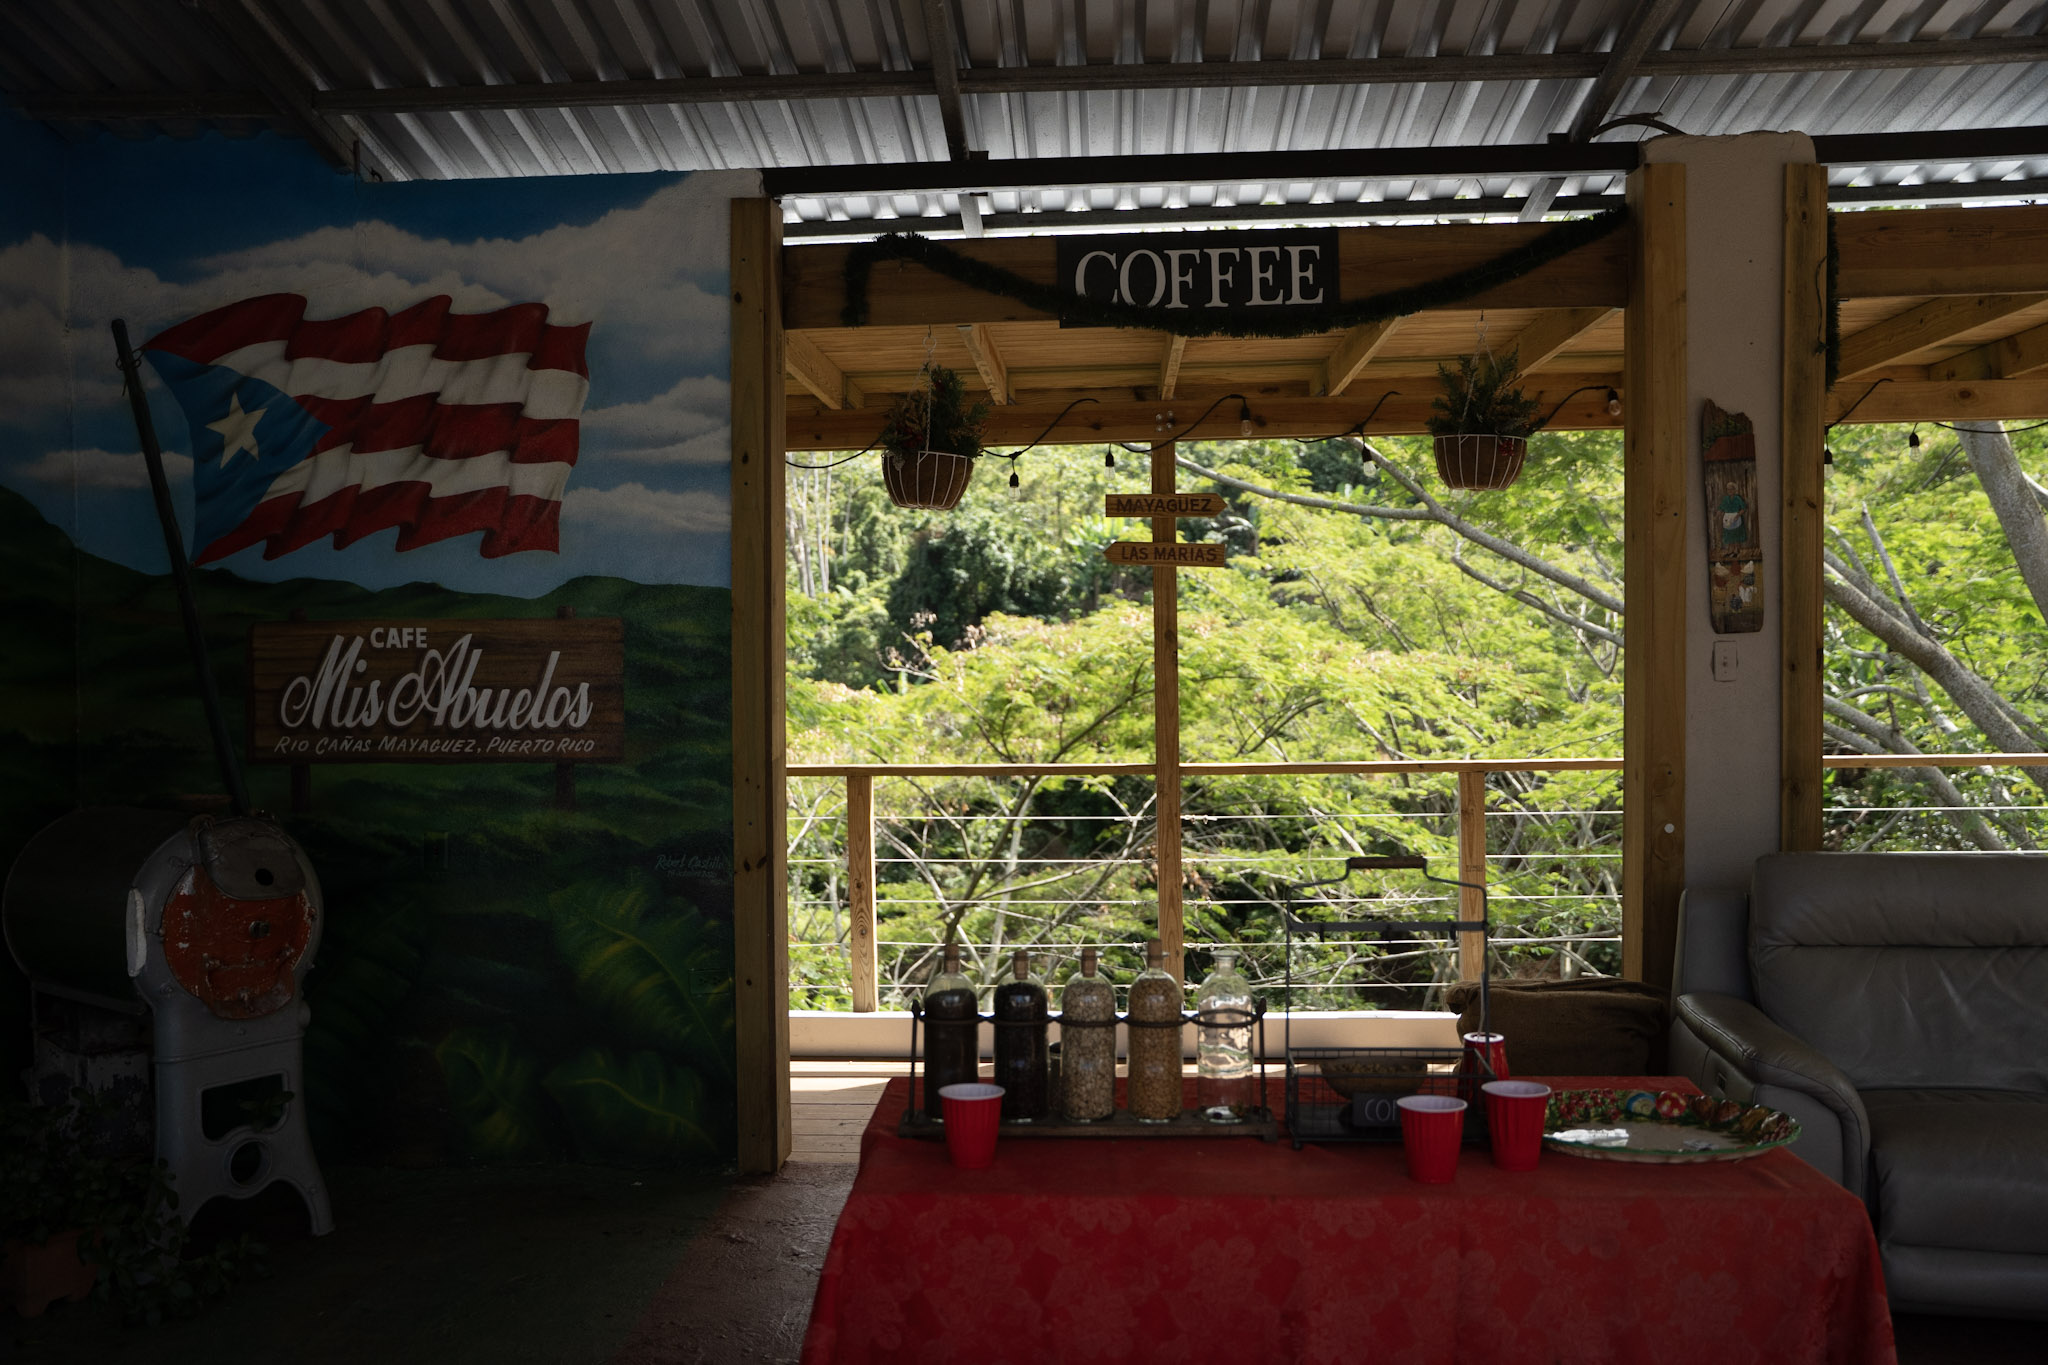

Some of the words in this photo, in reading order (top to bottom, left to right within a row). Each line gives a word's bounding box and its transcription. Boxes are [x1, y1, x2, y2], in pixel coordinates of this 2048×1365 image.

[1075, 245, 1323, 309] COFFEE
[1121, 546, 1148, 560] LAS
[1153, 547, 1217, 562] MARIAS
[370, 627, 427, 648] CAFE
[281, 634, 384, 729] Mis
[387, 633, 594, 730] Abuelos
[274, 735, 310, 754] RIO
[315, 735, 372, 755] CAÑAS
[486, 736, 555, 754] PUERTO
[557, 737, 595, 754] RICO
